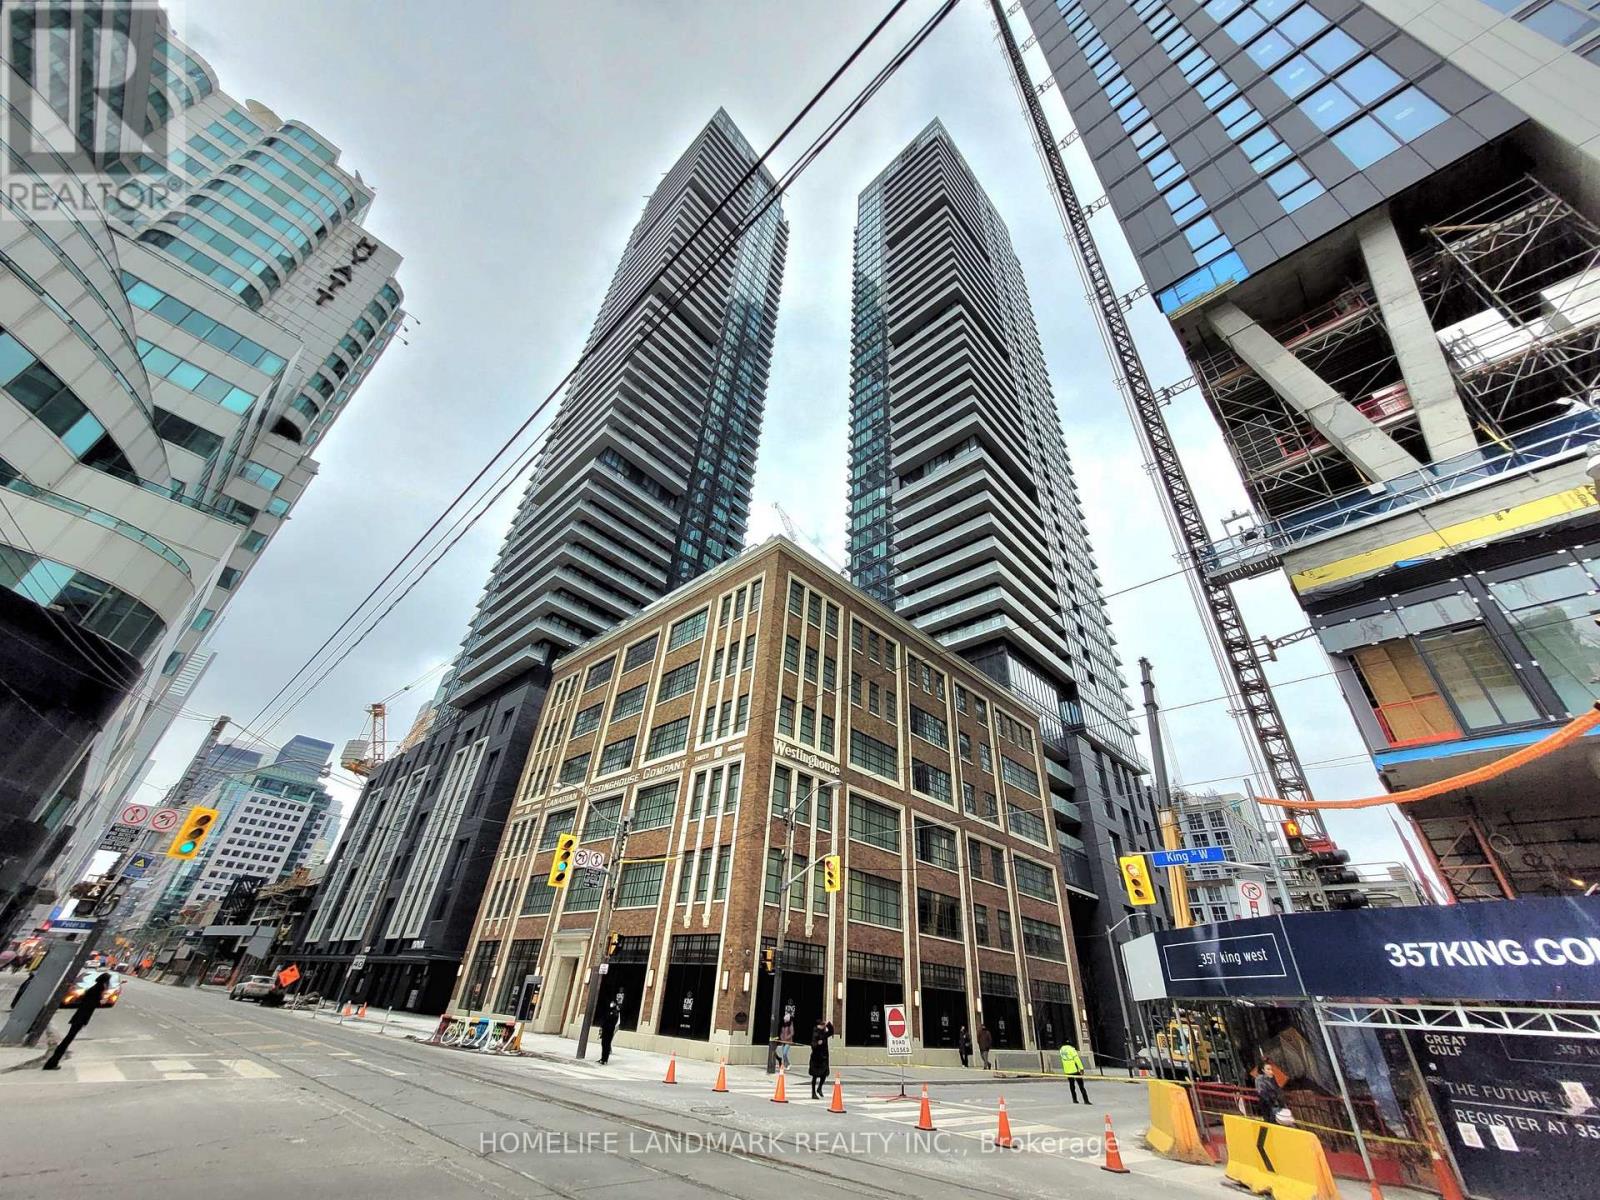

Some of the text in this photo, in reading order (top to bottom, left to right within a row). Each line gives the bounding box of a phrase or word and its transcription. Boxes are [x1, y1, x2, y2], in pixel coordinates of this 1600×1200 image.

[315, 236, 378, 306] HYATT
[773, 738, 840, 775] Westinghouse
[546, 792, 577, 807] CANADIAN
[643, 759, 688, 780] COMPANY
[1166, 851, 1189, 863] King
[1199, 849, 1208, 860] W
[1219, 951, 1242, 965] king
[1243, 948, 1268, 962] west
[1424, 1034, 1467, 1047] GREAT
[1428, 1044, 1462, 1057] GULF
[1445, 1081, 1479, 1097] THE
[1481, 1085, 1555, 1105] FUTURE
[1455, 1109, 1542, 1133] REGISTER
[1548, 1120, 1570, 1136] AT
